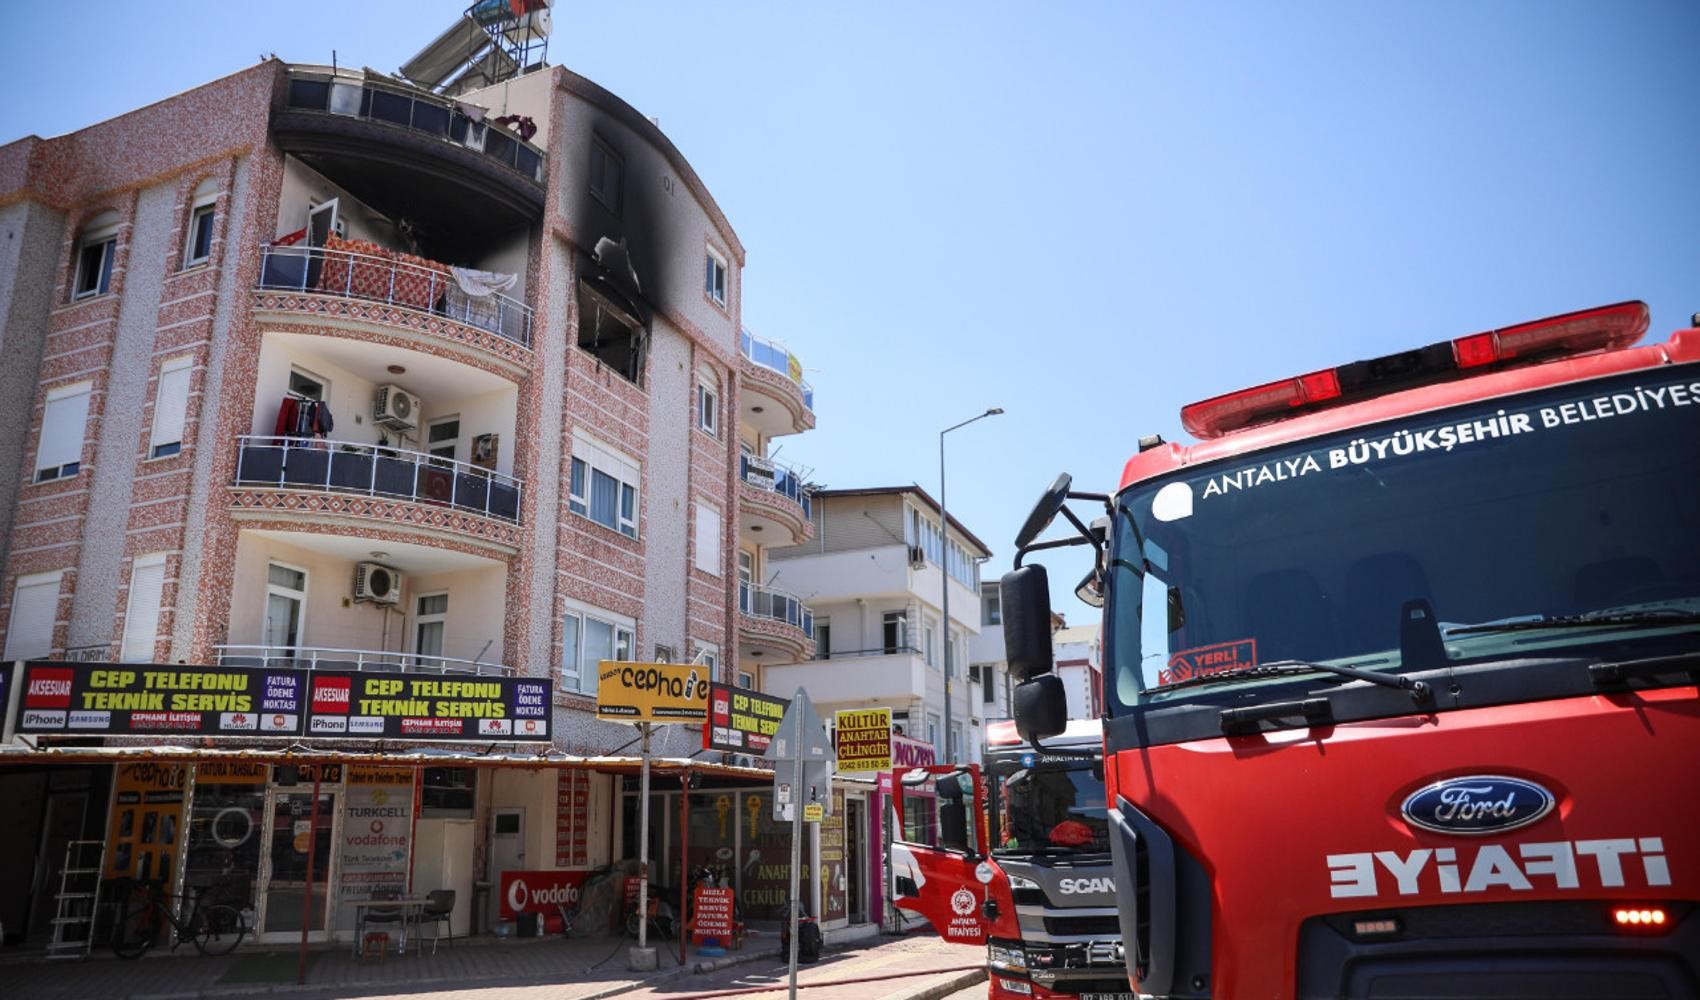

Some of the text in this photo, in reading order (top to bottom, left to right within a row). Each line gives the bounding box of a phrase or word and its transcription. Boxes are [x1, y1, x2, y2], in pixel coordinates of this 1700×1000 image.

[1202, 454, 1322, 499] ANTALYA
[1329, 408, 1535, 469] BÜYÜKŞEHİR
[1194, 646, 1238, 666] YERLİ
[28, 679, 72, 696] AKSESUAR
[90, 670, 248, 691] CEP TELEFONU
[266, 675, 297, 687] FATURA
[267, 687, 295, 699] ÖDEME
[313, 687, 350, 703] AKSESUAR
[365, 679, 502, 699] CEP TELEFONU
[517, 684, 544, 694] FATURA
[82, 690, 253, 712] TEKNİK SERVİS
[263, 700, 297, 711] NOKTASI
[518, 694, 542, 705] ÖDEME
[733, 693, 749, 711] CEP
[359, 697, 506, 718] TEKNİK SERVİS
[515, 706, 545, 716] NOKTASI
[24, 714, 64, 725] iPhone
[69, 715, 110, 723] SAMSUNG
[312, 719, 345, 729] iPhone
[839, 711, 888, 729] KÜLTÜR
[839, 730, 889, 743] ANAHTAR
[838, 743, 889, 758] ÇİLİNGİR
[1434, 785, 1517, 822] Ford
[346, 835, 406, 846] vodafone
[757, 864, 810, 880] ANAHAR
[947, 924, 981, 937] İTFAİYESİ
